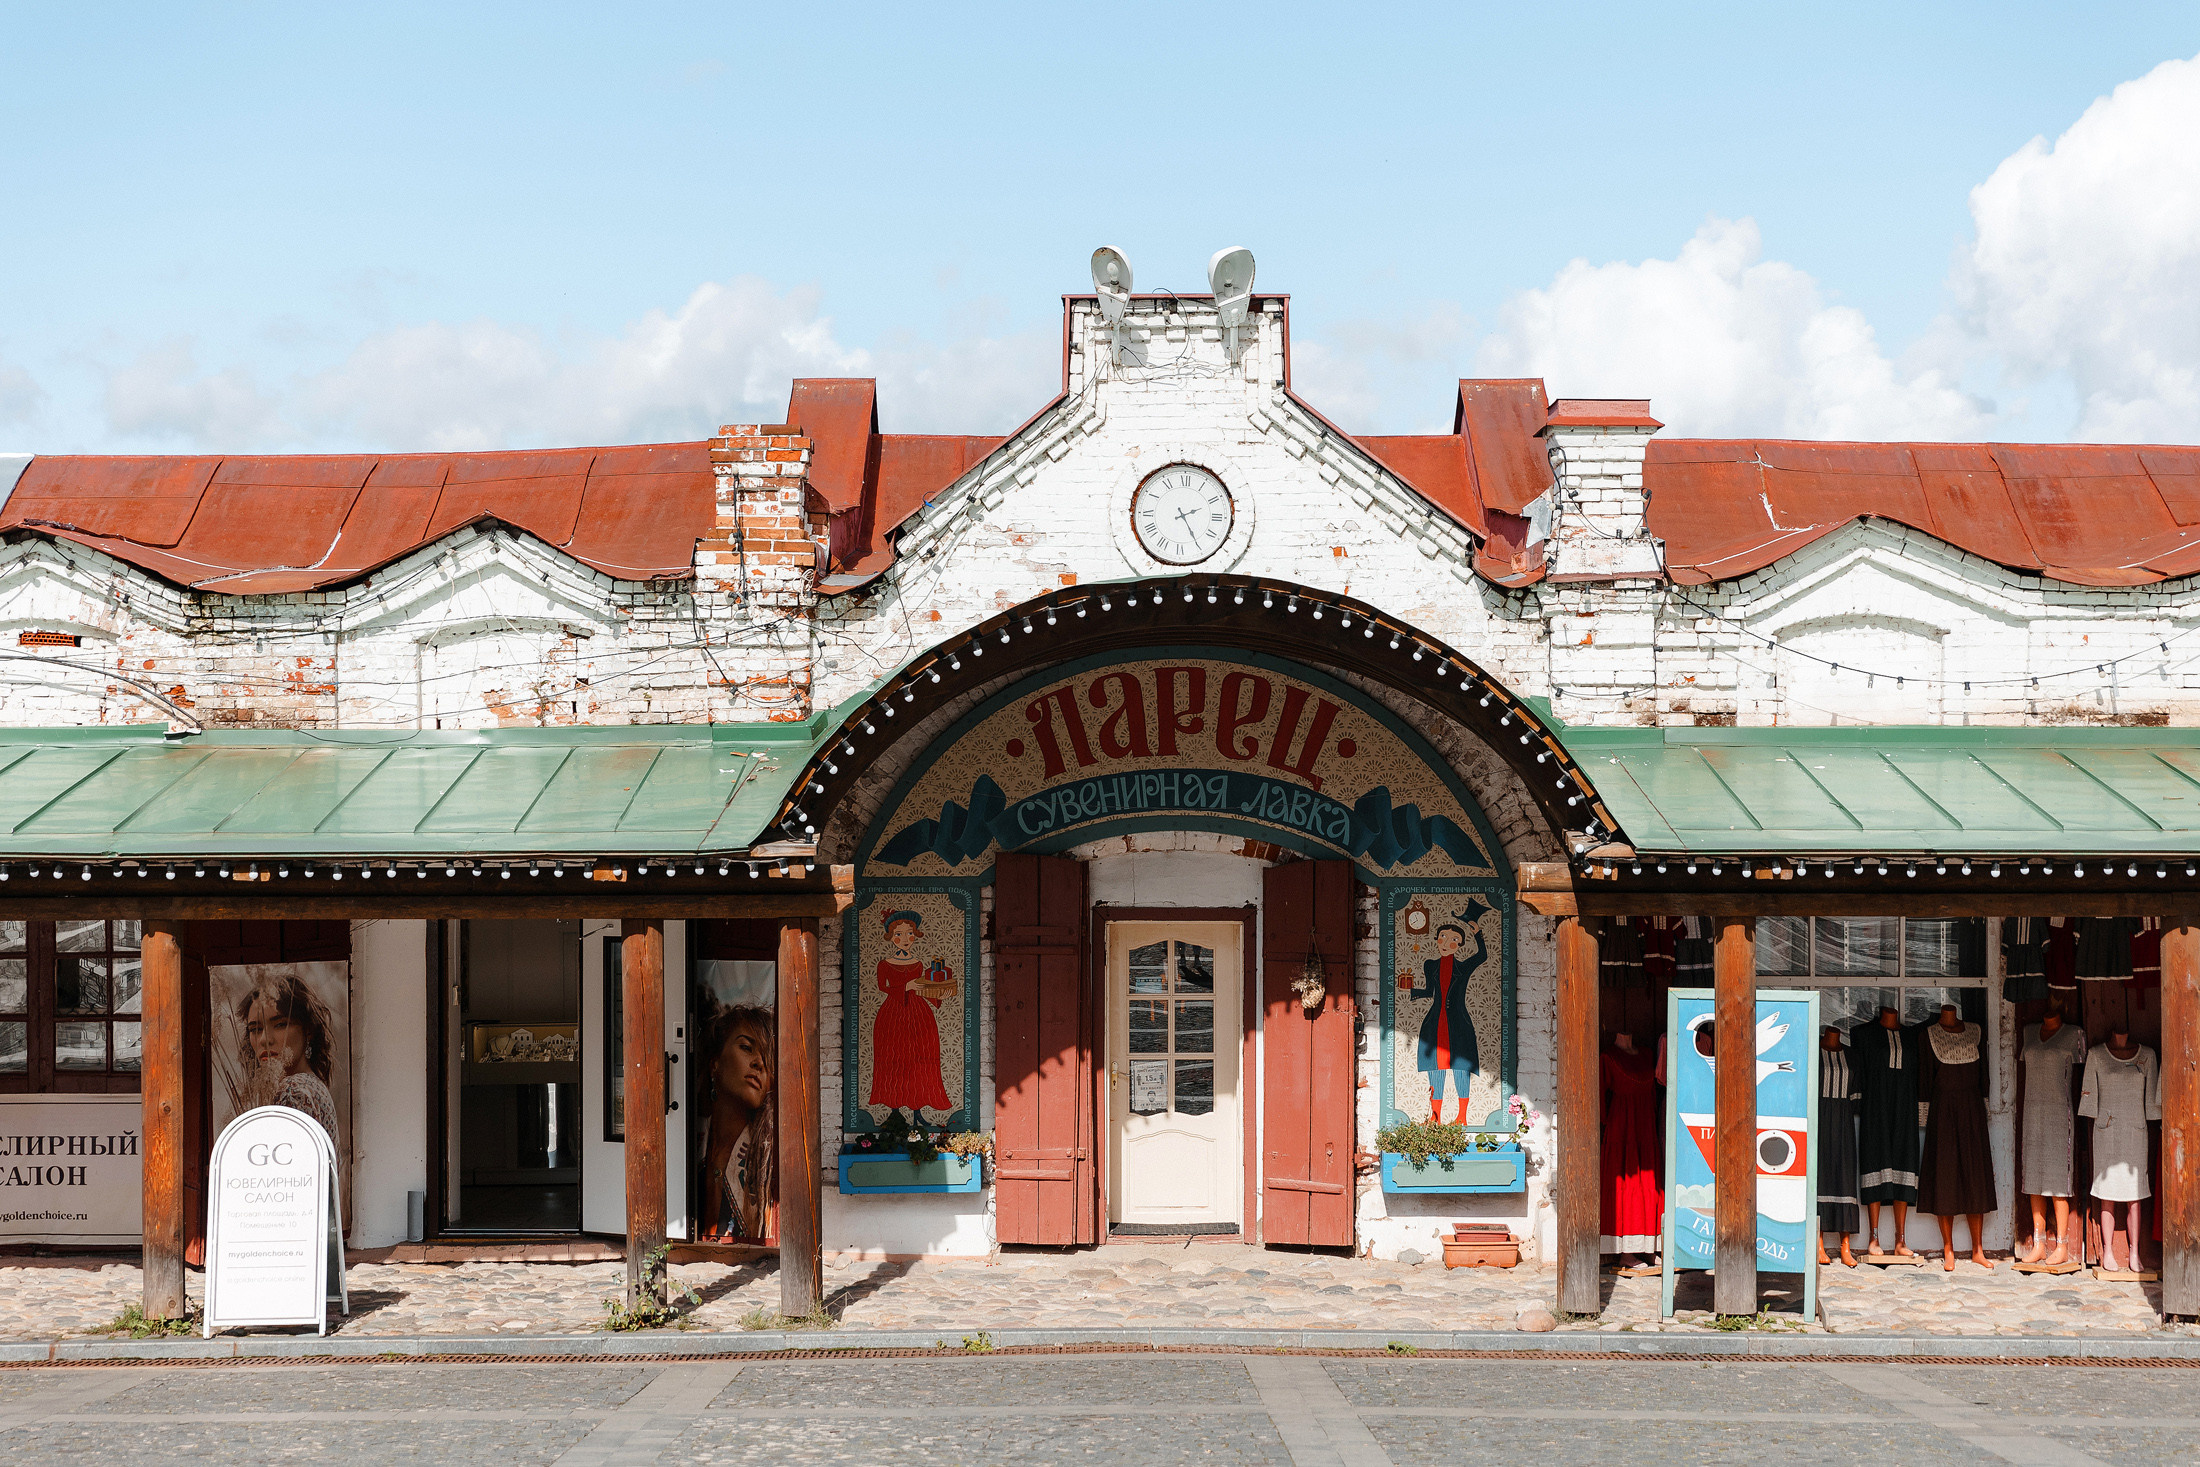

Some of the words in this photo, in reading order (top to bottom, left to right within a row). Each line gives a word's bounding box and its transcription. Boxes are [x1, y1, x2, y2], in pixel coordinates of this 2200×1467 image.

[1502, 980, 1509, 991] НЕ
[850, 1049, 858, 1065] ПРО
[0, 1130, 139, 1156] ЛИРНЫЙ
[247, 1142, 293, 1167] GC
[226, 1174, 313, 1190] ЮВЕЛИРНЫЙ
[244, 1191, 294, 1204] САЛОН
[228, 1249, 304, 1259] mygoldenchoice.ru
